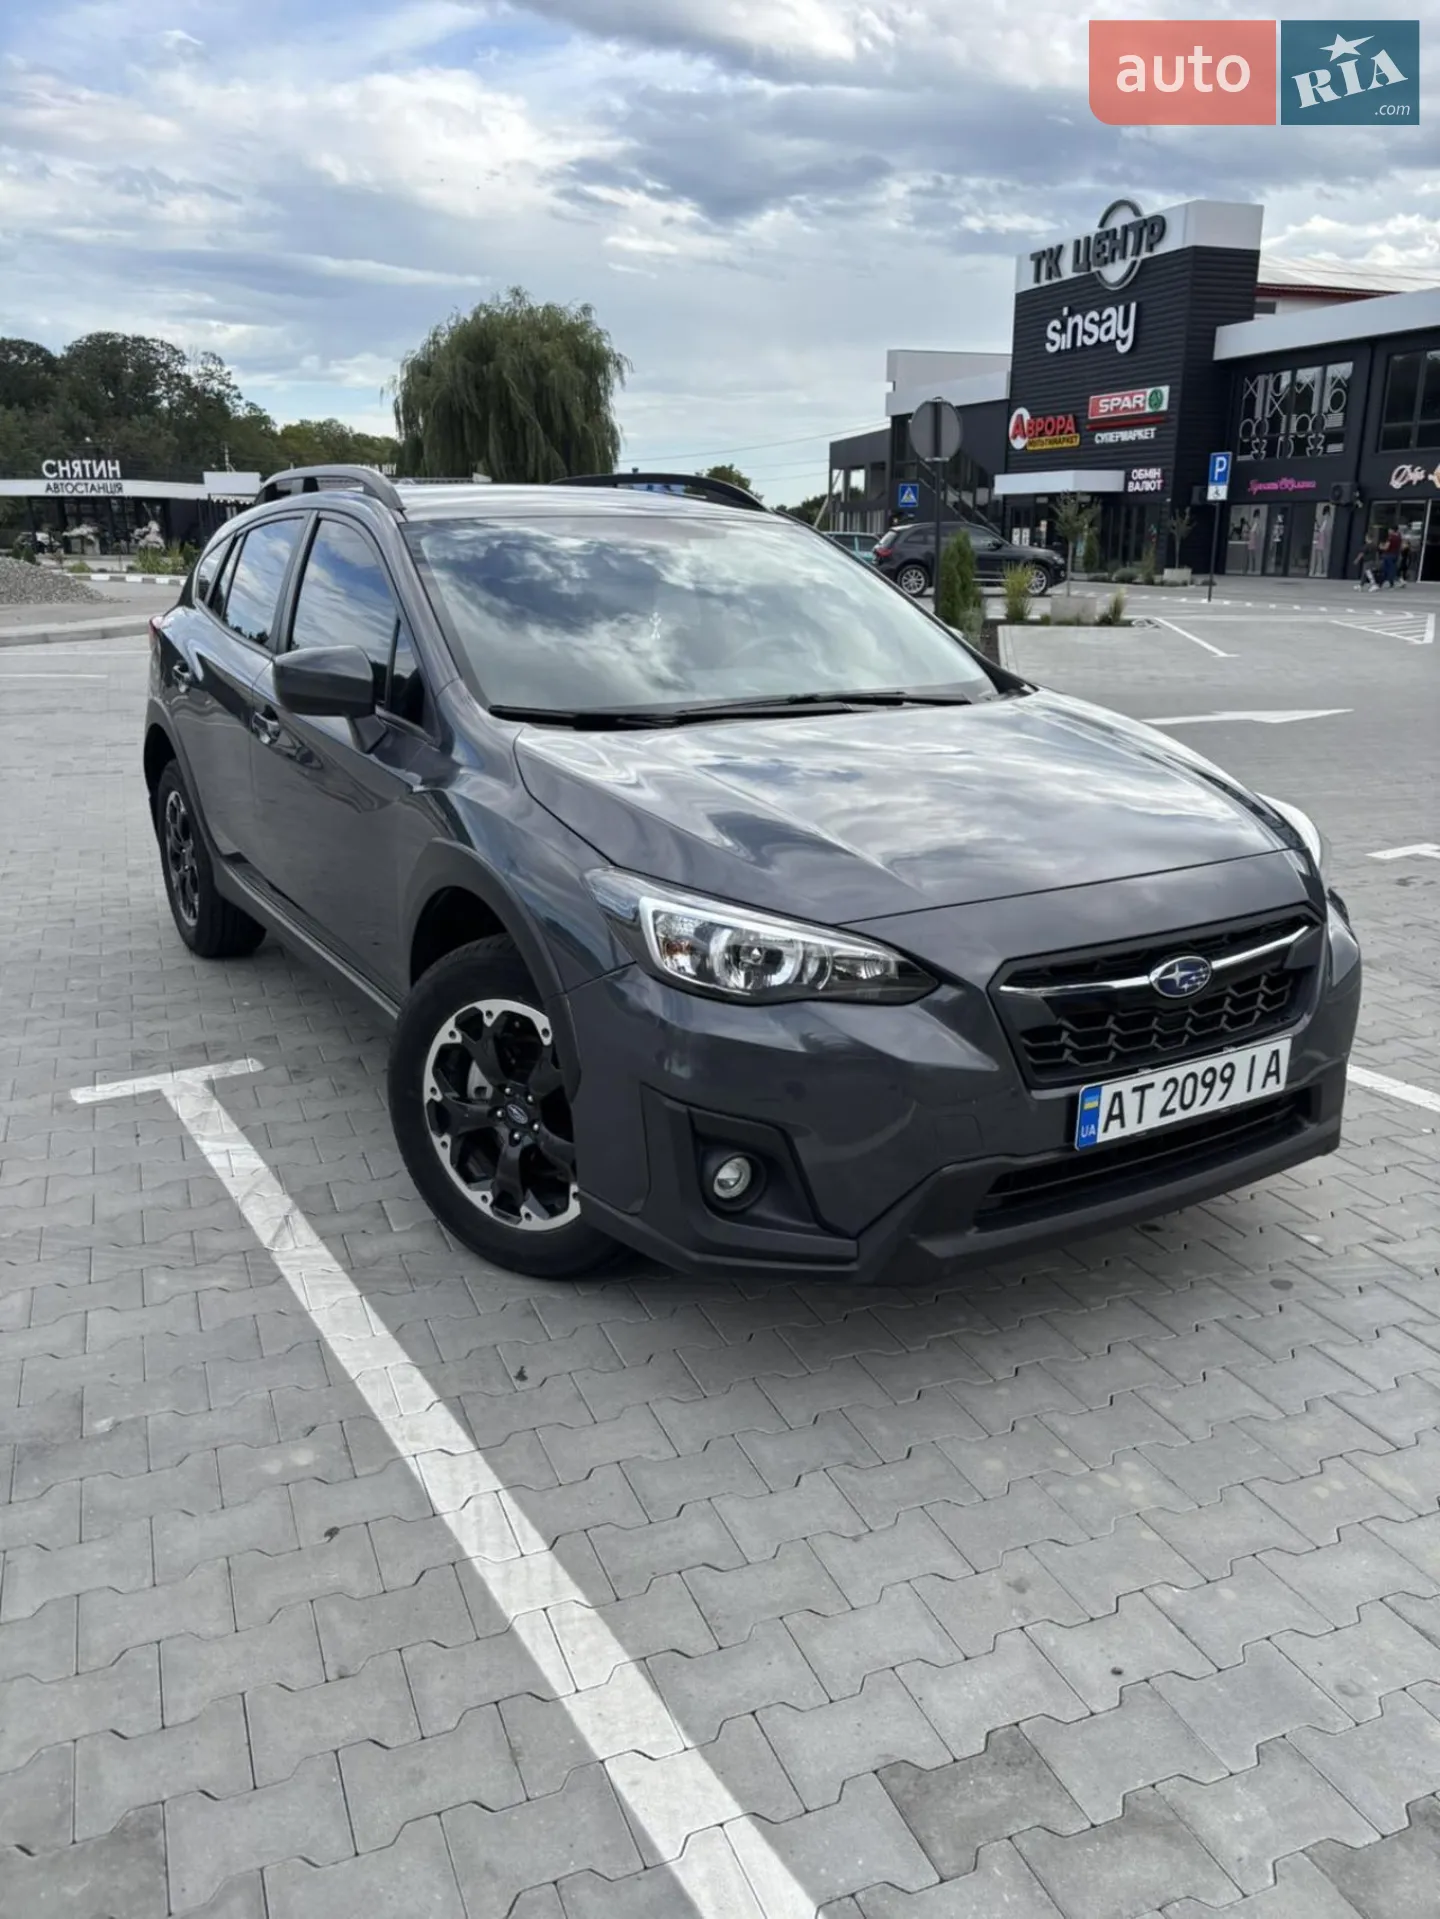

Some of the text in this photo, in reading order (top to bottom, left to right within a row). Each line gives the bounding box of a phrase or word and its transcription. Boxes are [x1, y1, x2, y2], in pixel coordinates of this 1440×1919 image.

[1030, 214, 1166, 283] ТК ЦЕНТР
[1045, 302, 1136, 353] sinsay
[1099, 393, 1145, 413] SPAR
[1010, 413, 1076, 440] АВРОРА
[1095, 427, 1156, 444] СУПЕРМАРКЕТ
[42, 459, 121, 479] СНЯТИН
[1131, 468, 1161, 480] ОБМІН
[1214, 456, 1227, 480] P
[45, 482, 123, 494] АВТОСТАНЦІЯ
[1128, 479, 1163, 492] ВАЛЮТ
[1102, 1082, 1155, 1133] AT
[1159, 1062, 1236, 1119] 2099
[1081, 1125, 1096, 1138] UA
